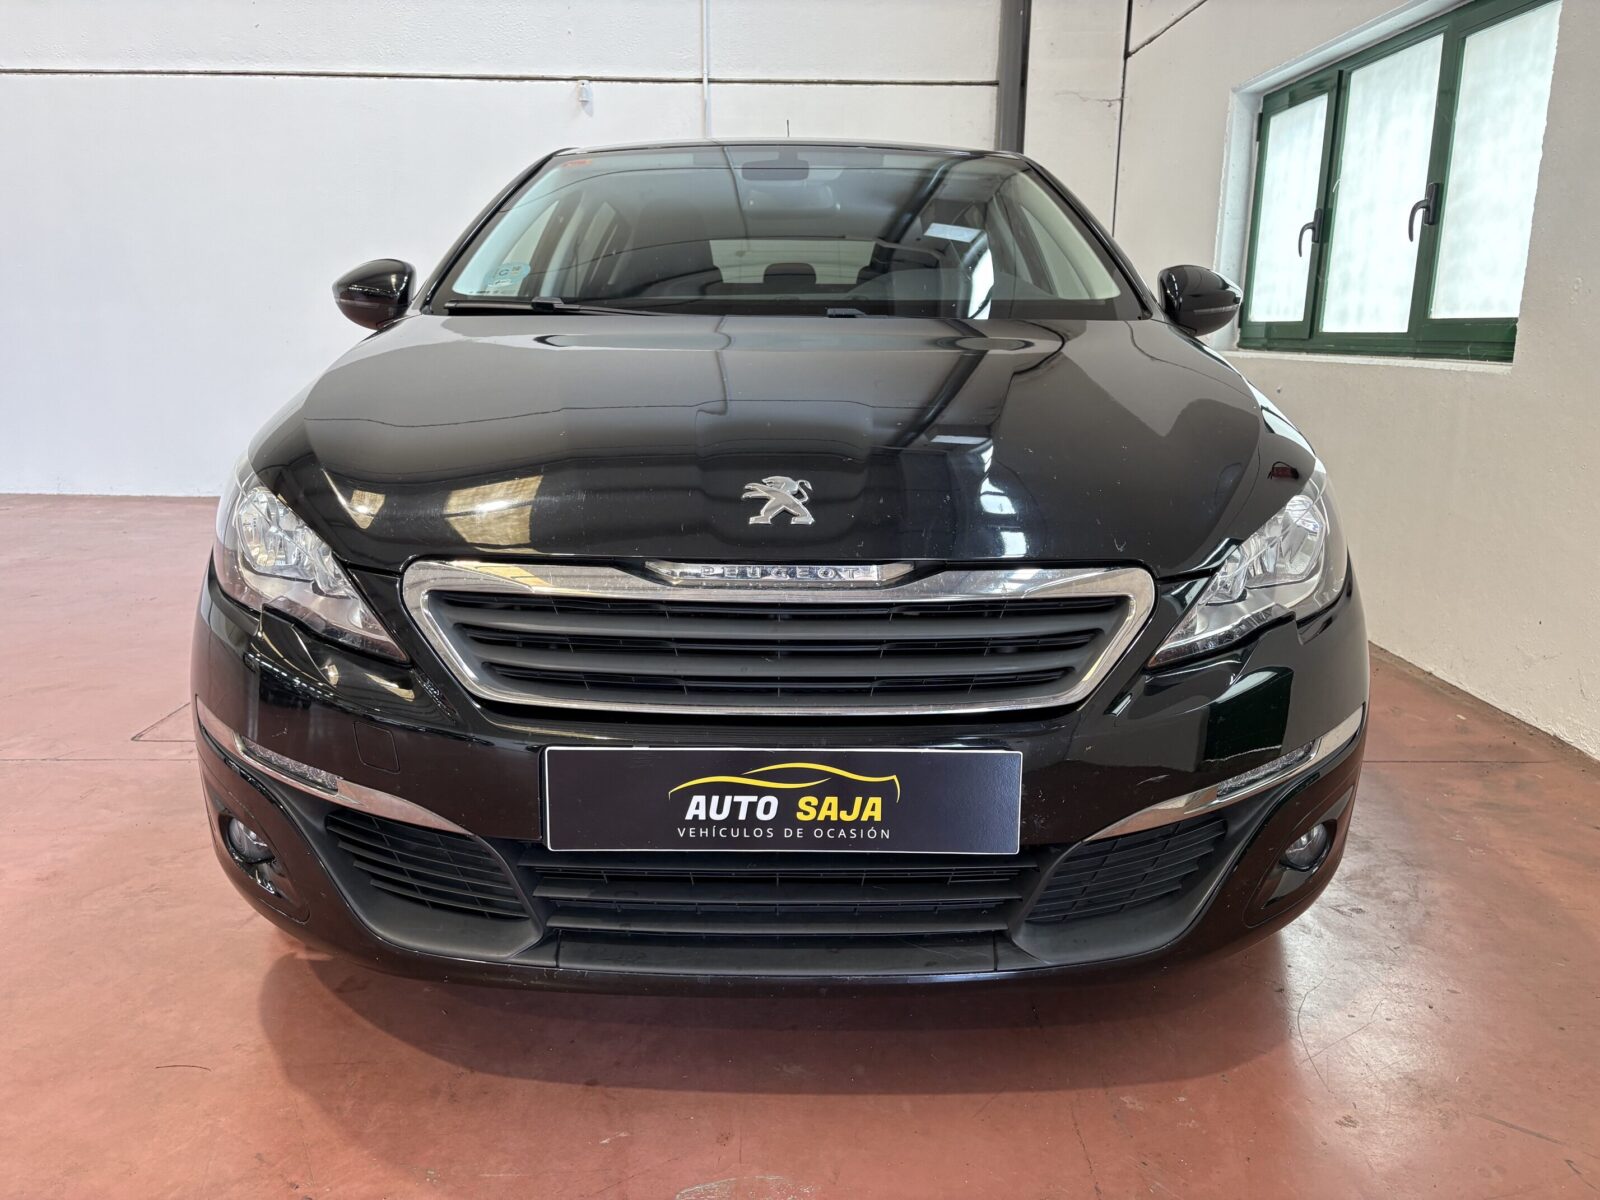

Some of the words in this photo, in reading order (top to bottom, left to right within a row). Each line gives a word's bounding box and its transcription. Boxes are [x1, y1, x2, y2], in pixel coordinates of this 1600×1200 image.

[700, 566, 858, 579] PEUGEOT
[685, 795, 779, 821] AUTO
[796, 796, 882, 822] SAJA
[677, 826, 774, 839] VEHÍCULOS
[784, 827, 804, 839] DE
[813, 825, 890, 840] OCASIÓN
